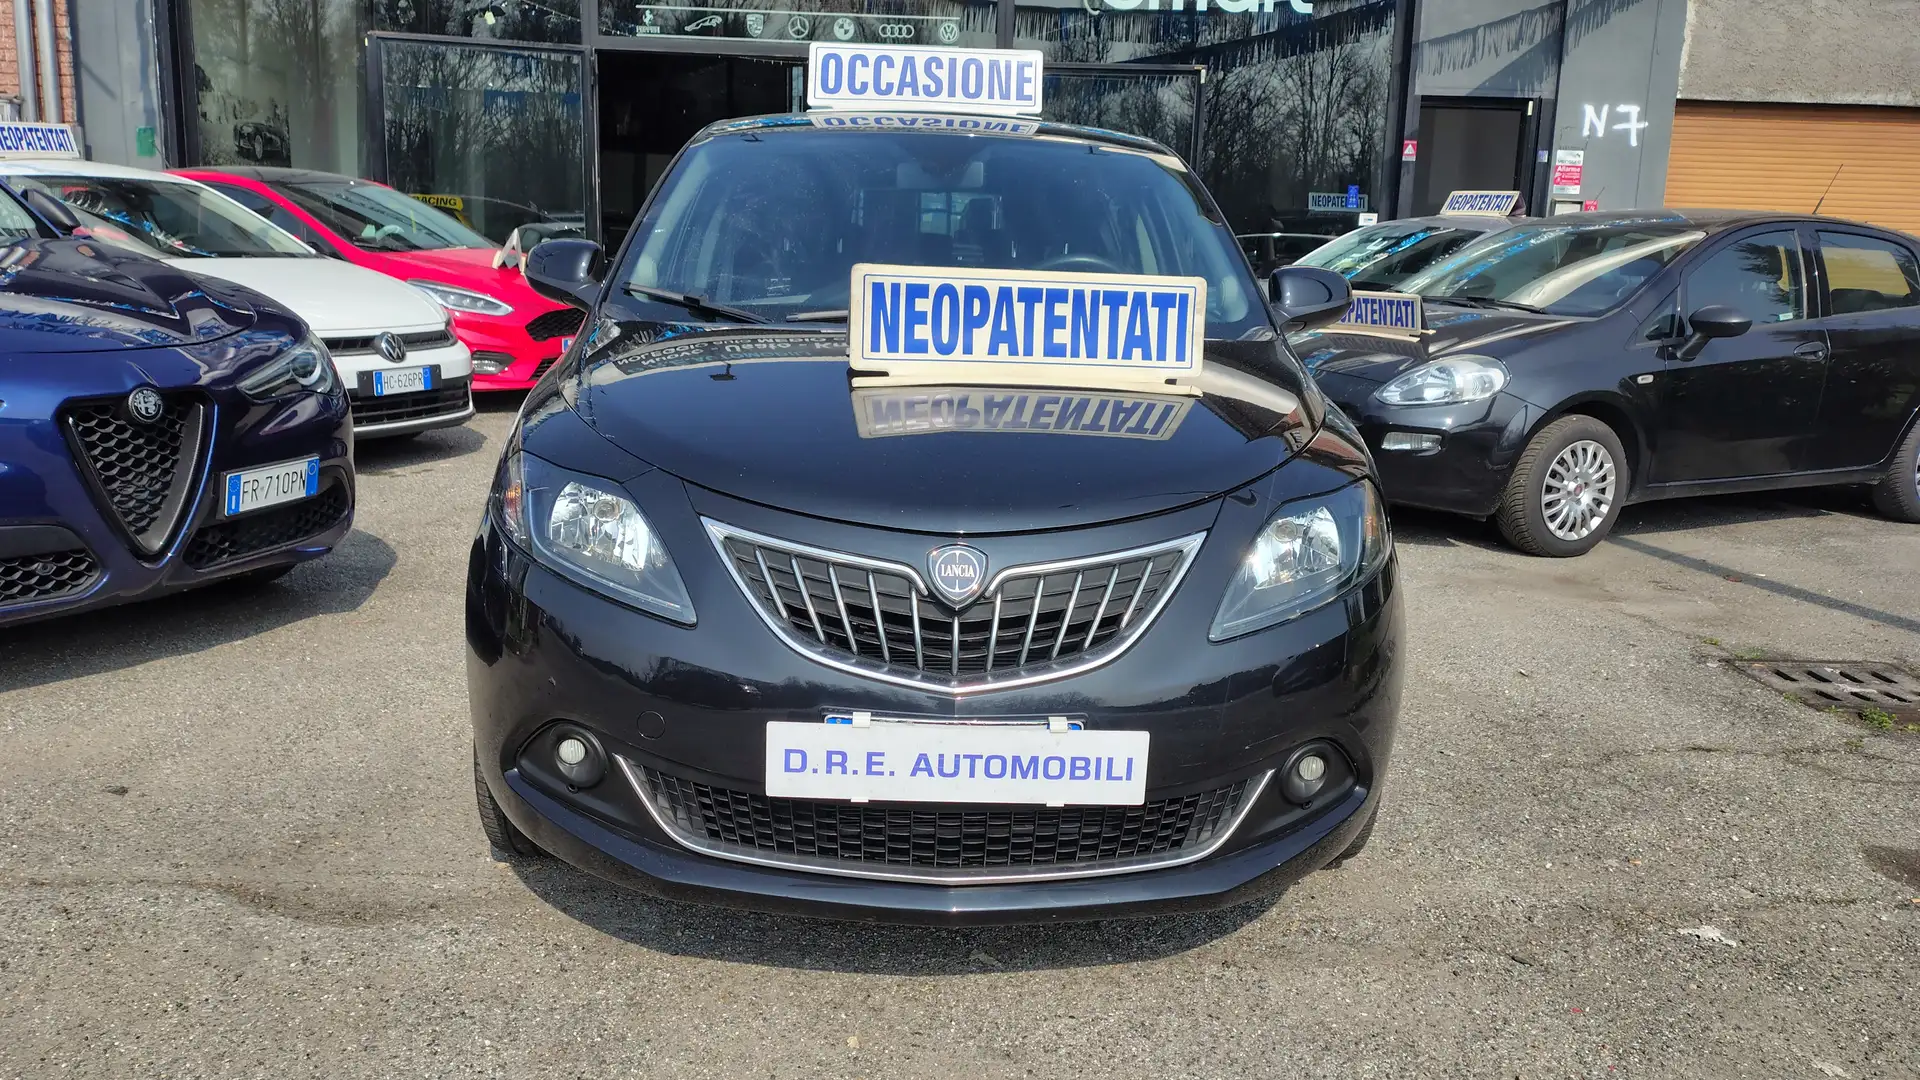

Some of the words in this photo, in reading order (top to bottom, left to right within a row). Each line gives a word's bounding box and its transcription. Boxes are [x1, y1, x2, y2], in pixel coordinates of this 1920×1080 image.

[820, 53, 1033, 101] OCCASIONE
[1583, 104, 1609, 137] N
[1612, 104, 1648, 146] 7
[1311, 194, 1365, 208] NEOPATETI
[1446, 194, 1514, 211] NEOPATENTATI
[870, 281, 1189, 362] NEOPATENTATI
[1340, 297, 1415, 328] PATENTATI
[941, 564, 975, 578] LANCIA
[784, 748, 895, 777] D.R.E.
[909, 752, 1134, 782] AUTOMOBILI
